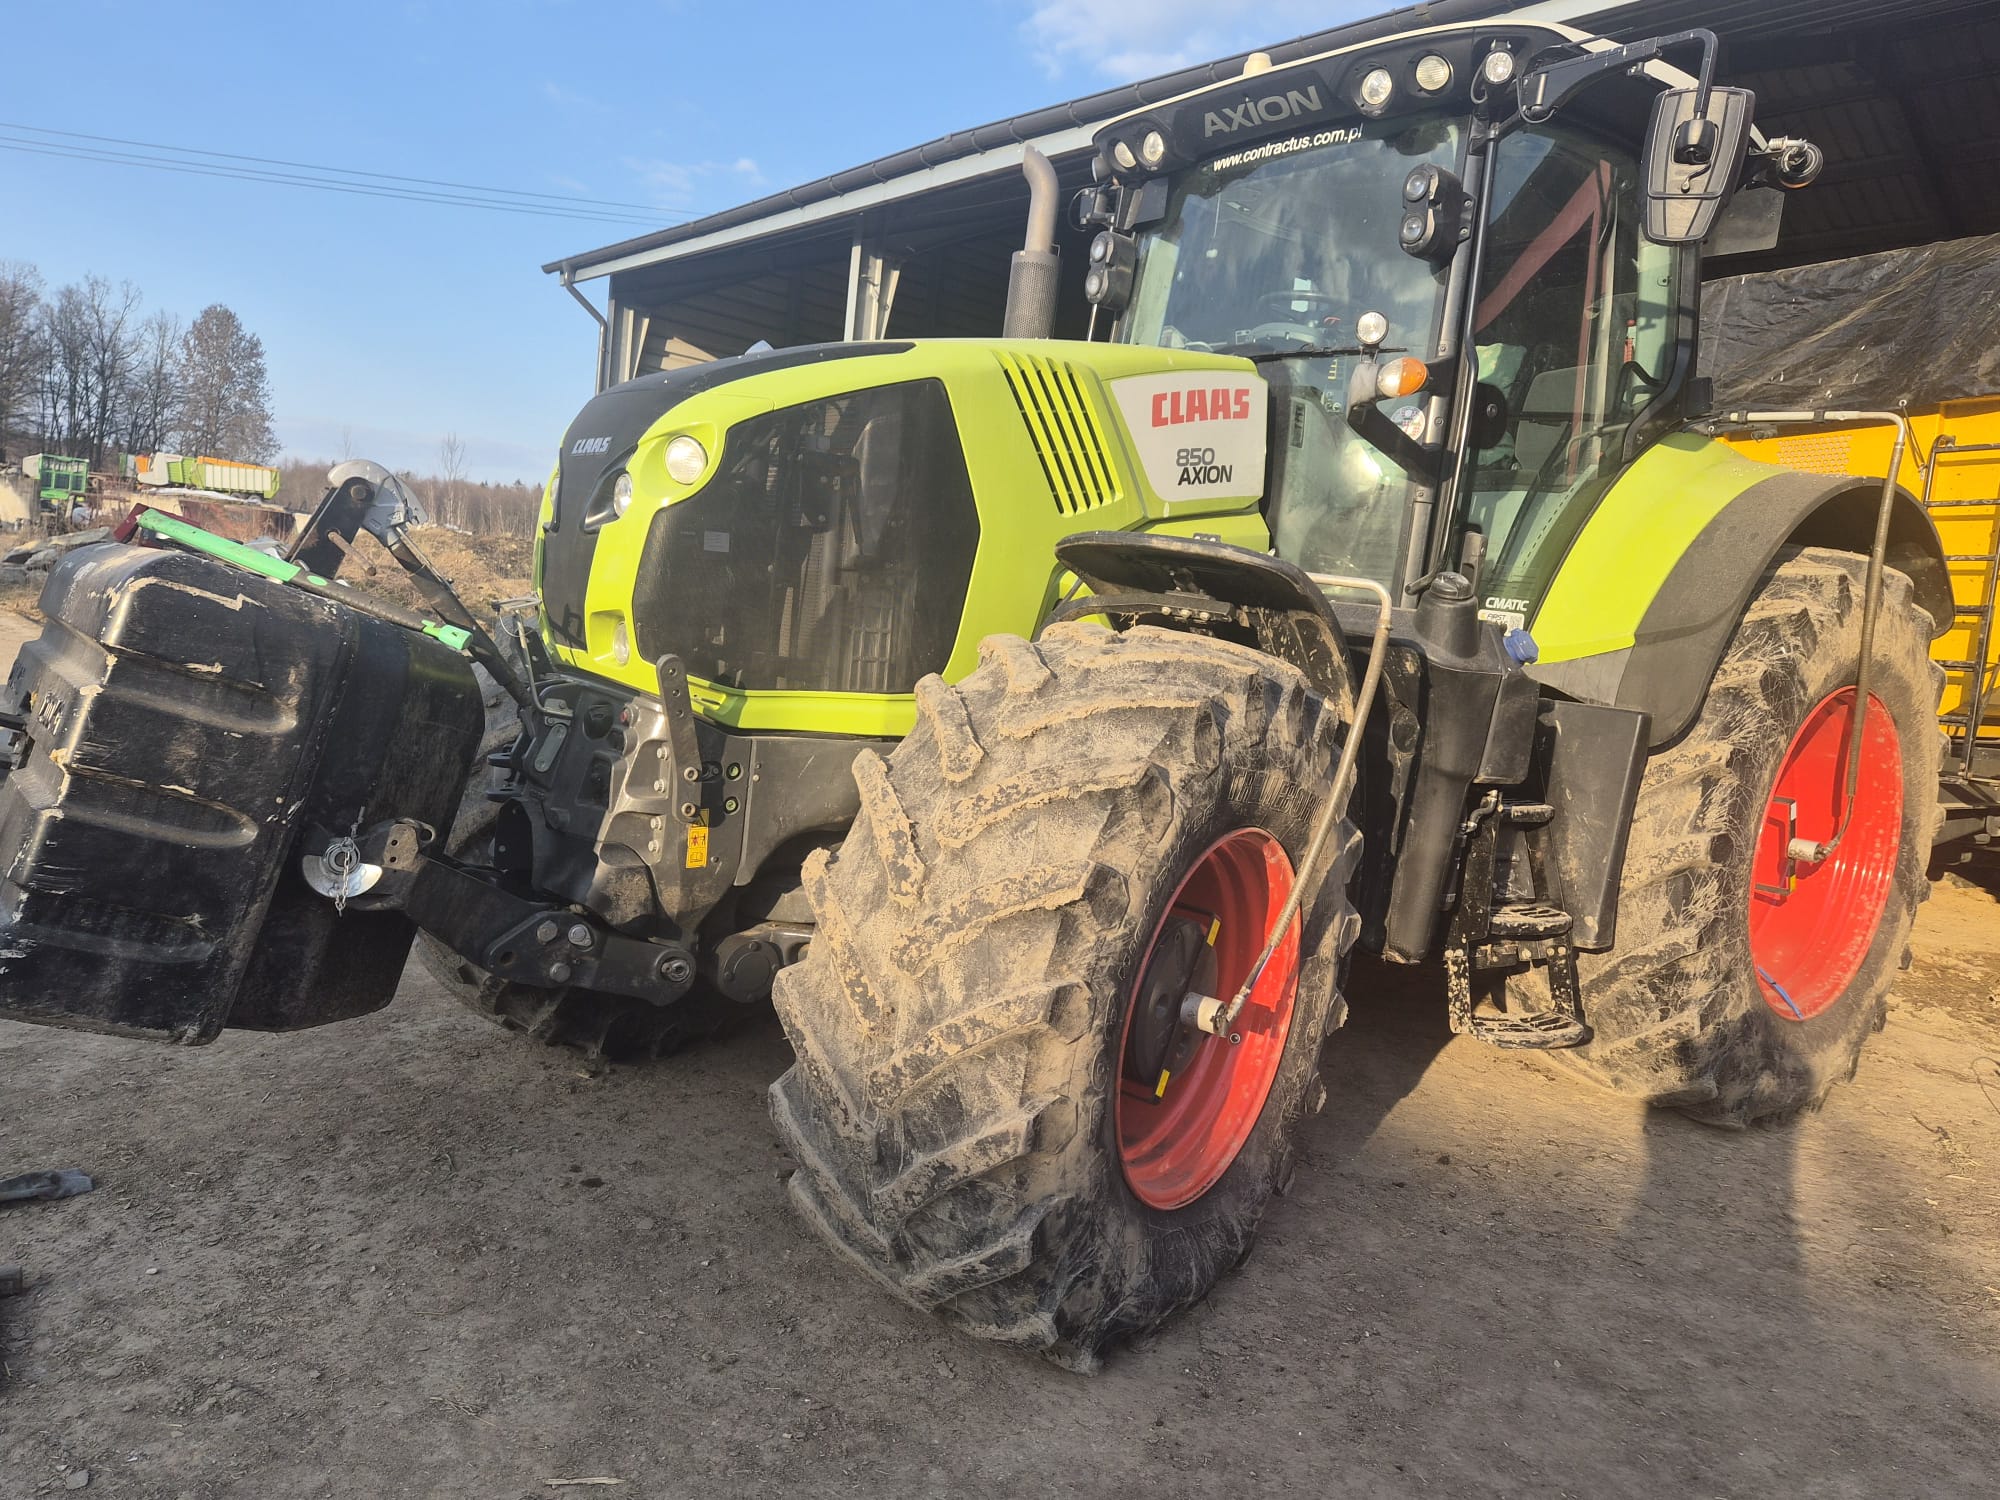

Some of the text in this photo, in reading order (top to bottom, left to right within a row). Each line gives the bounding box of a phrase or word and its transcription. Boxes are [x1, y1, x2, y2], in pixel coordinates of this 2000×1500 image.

[1204, 85, 1323, 137] AXION
[1213, 122, 1364, 171] www.contractus.com.pl
[1152, 388, 1250, 428] CLAAS
[571, 436, 613, 455] CLAAS
[1176, 447, 1215, 467] 850
[1178, 465, 1233, 486] AXION
[1485, 597, 1530, 612] CMATIC
